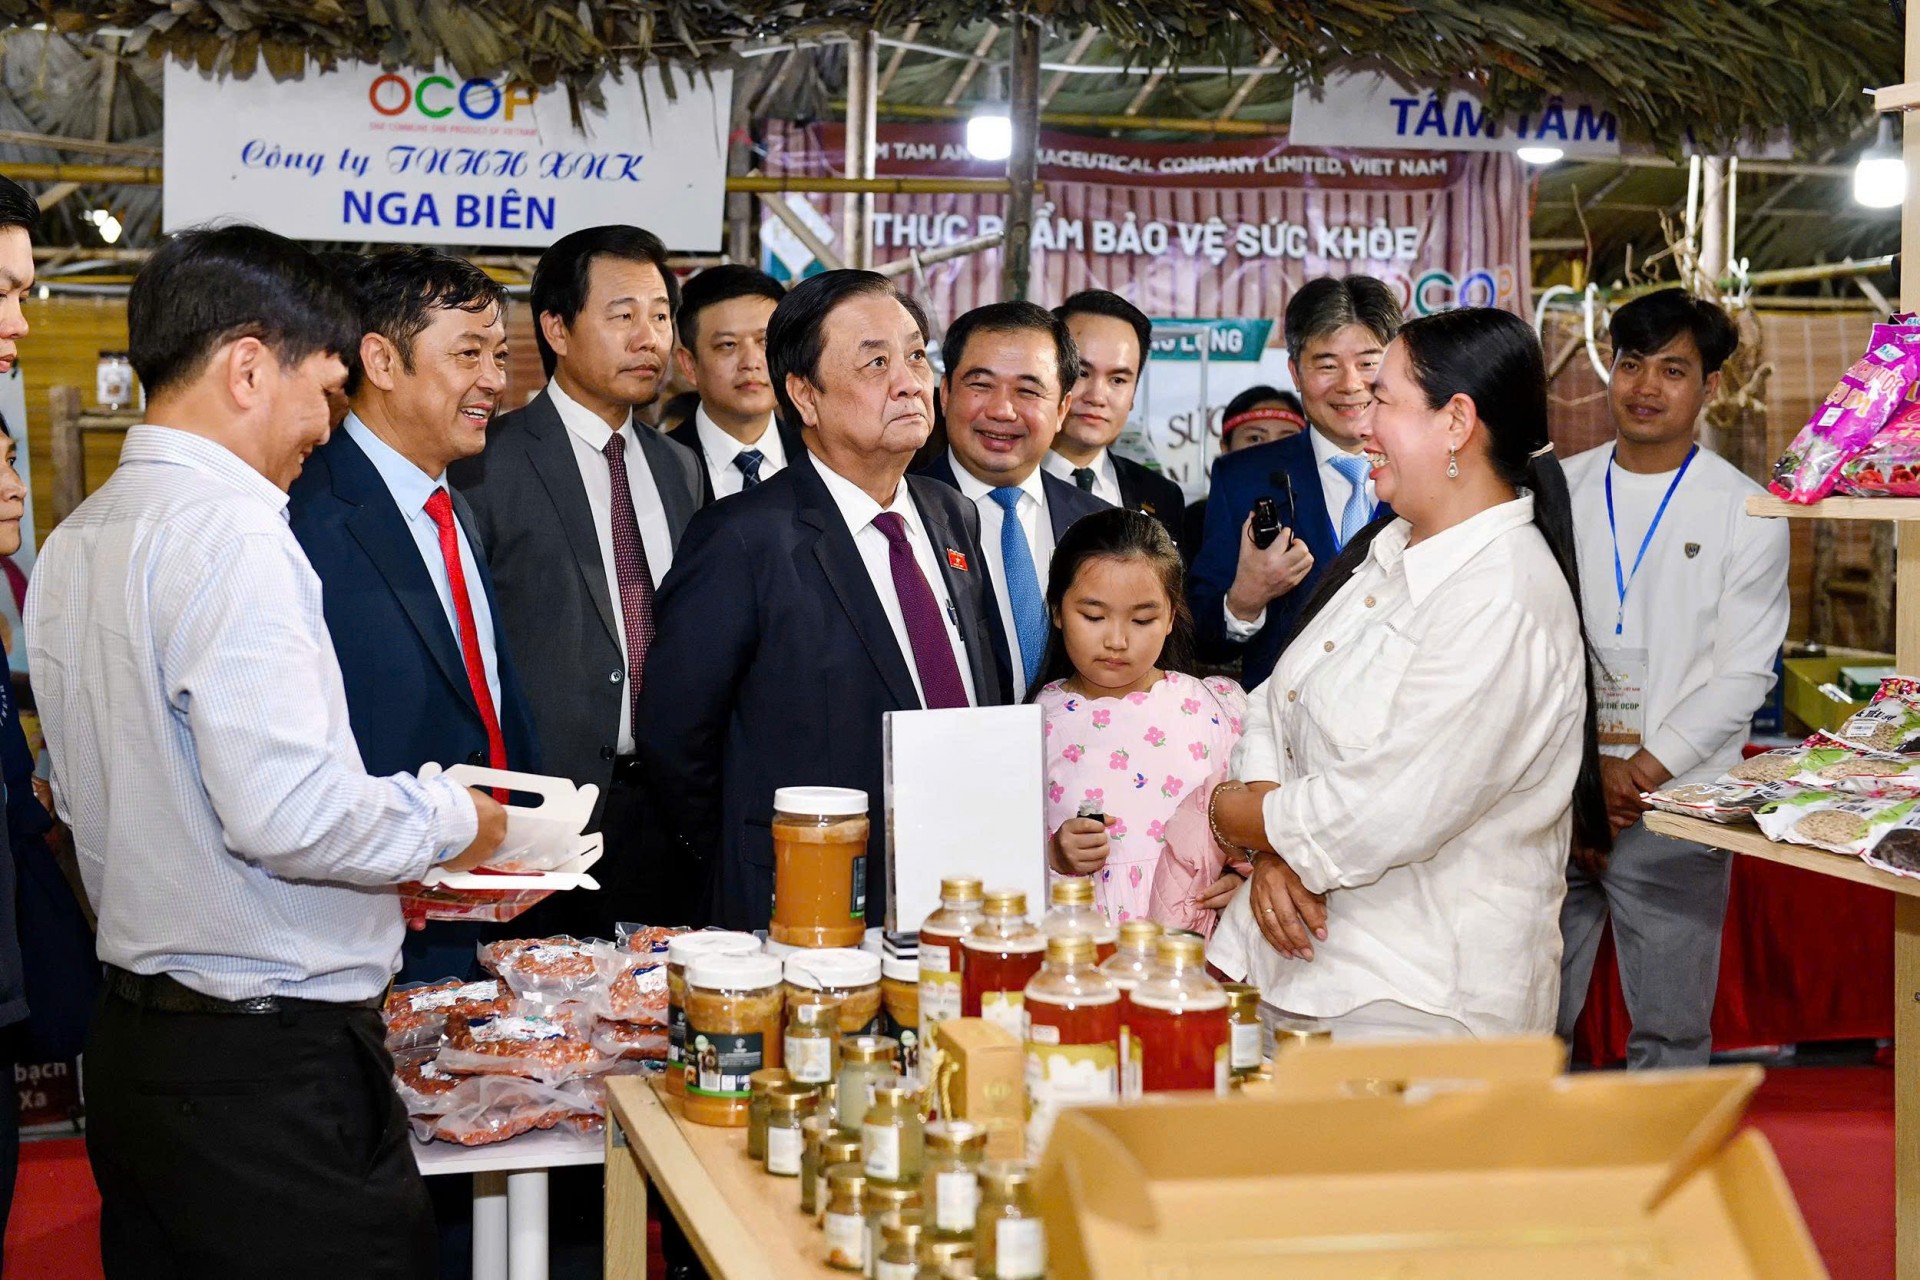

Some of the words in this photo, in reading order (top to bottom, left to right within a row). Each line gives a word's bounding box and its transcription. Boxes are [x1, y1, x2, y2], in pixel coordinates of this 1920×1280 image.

[369, 74, 538, 120] OCOP
[241, 139, 325, 177] Công
[339, 148, 371, 177] ty
[1158, 155, 1258, 174] COMPANY
[1399, 158, 1447, 176] NAM
[343, 190, 440, 226] NGA
[456, 188, 555, 230] BIÊN
[977, 201, 1084, 251] PẨM
[1092, 211, 1169, 256] BẢO
[1176, 216, 1229, 266] VỆ
[1235, 216, 1308, 259] SỨC
[1315, 217, 1418, 261] KHỎE
